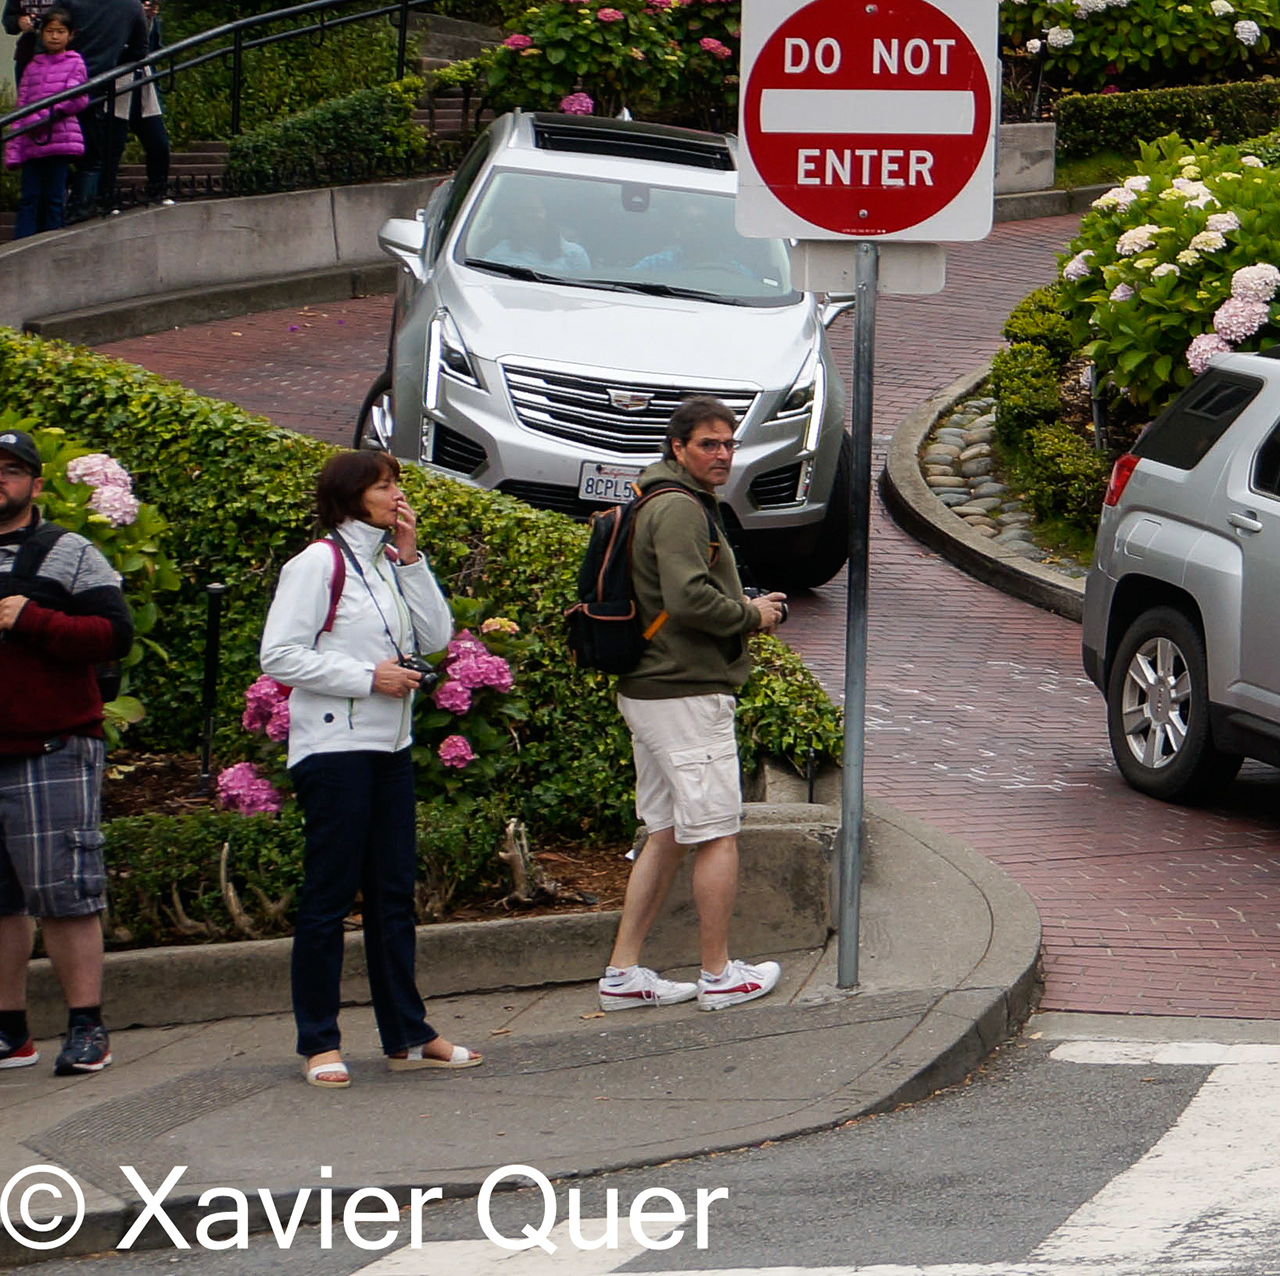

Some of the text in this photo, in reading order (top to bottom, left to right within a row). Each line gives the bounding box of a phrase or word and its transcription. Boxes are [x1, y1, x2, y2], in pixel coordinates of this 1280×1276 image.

[784, 37, 956, 75] DO NOT
[797, 148, 934, 186] ENTER
